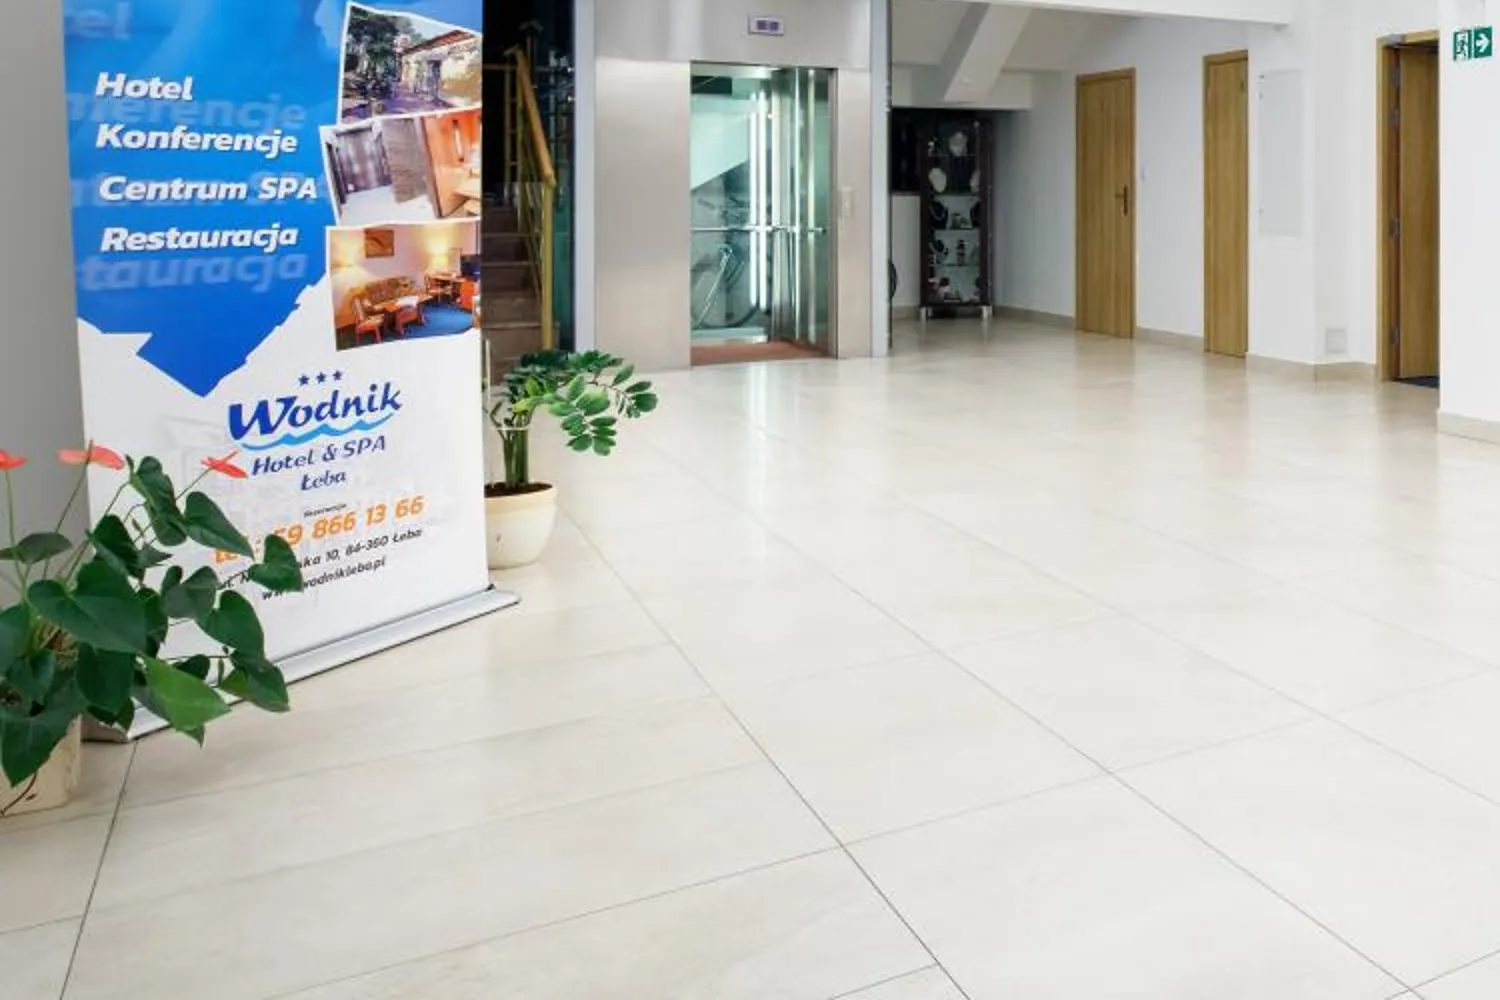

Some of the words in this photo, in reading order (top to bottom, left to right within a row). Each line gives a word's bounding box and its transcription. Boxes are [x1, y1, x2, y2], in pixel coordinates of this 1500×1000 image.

[64, 1, 131, 41] el
[95, 71, 193, 101] Hotel
[96, 123, 297, 158] Konferencje
[100, 175, 247, 201] Centrum
[258, 177, 318, 200] SPA
[101, 223, 298, 253] Restauracja
[229, 382, 402, 440] Wodnik
[252, 450, 314, 476] Hotel
[322, 443, 338, 462] &
[343, 435, 386, 457] SPA
[312, 511, 356, 539] 866
[366, 503, 387, 526] 13
[395, 495, 425, 518] 66
